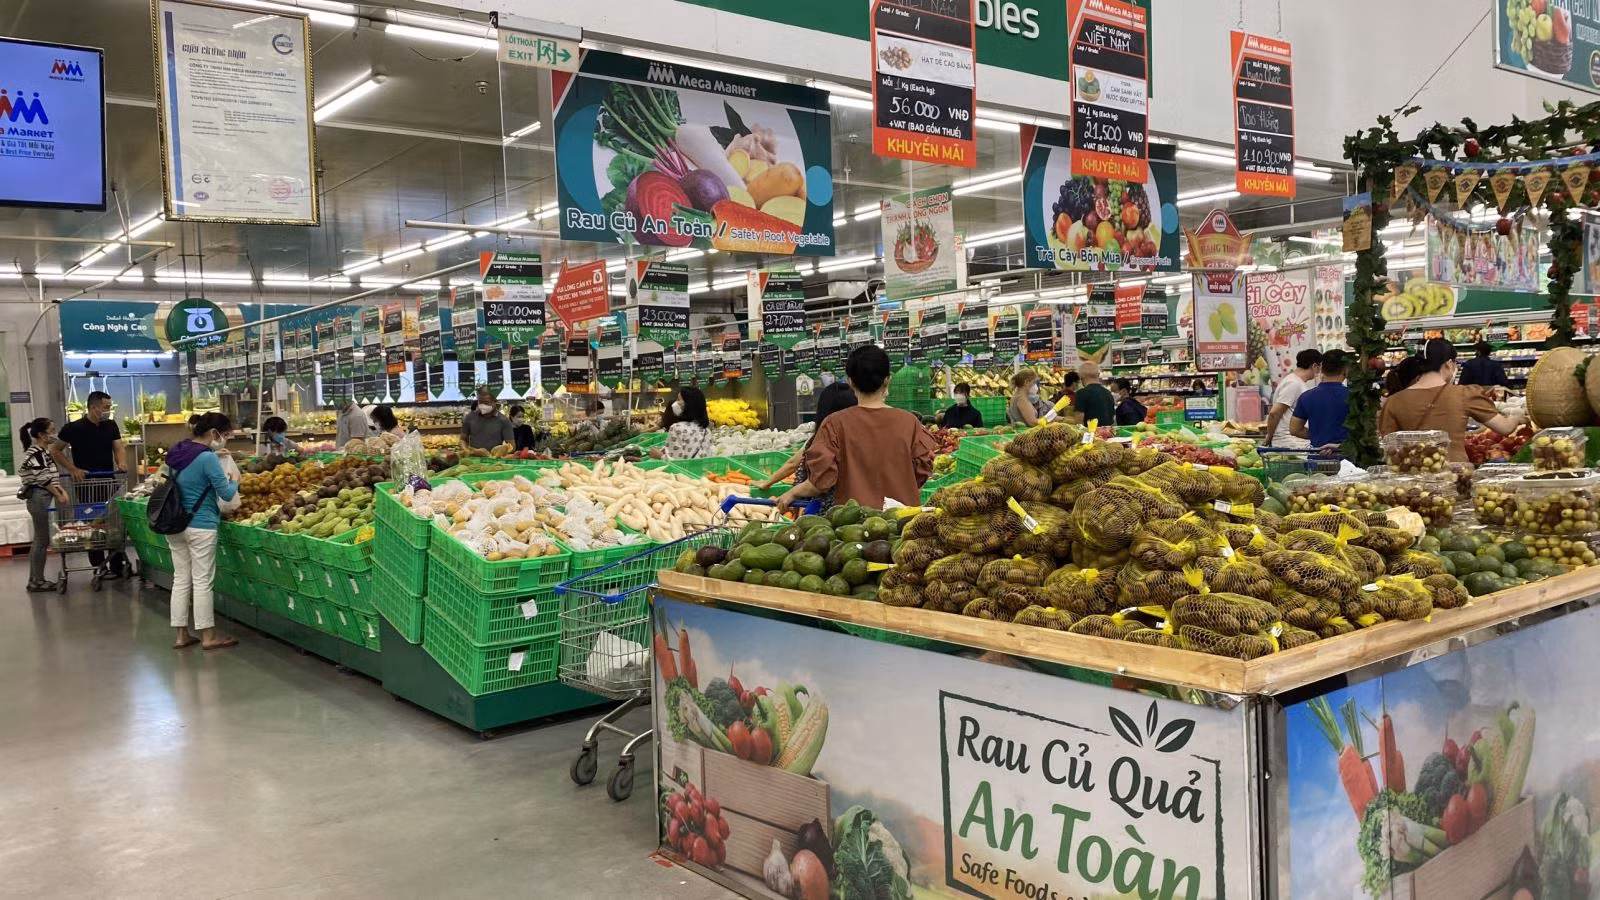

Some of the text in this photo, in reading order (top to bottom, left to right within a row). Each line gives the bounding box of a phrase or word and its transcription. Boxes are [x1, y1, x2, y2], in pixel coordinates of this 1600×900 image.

[508, 49, 533, 61] EXIT
[679, 75, 757, 99] Mega Market
[890, 97, 970, 122] 56.000 VNĐ
[889, 120, 907, 129] +VAT
[908, 121, 924, 132] (BAO
[1084, 120, 1144, 143] 21.500 VNĐ
[888, 137, 964, 161] KHUYẾN MÃI
[1082, 157, 1140, 178] KHUYẾN MÃI
[1244, 176, 1275, 191] KHUYẾN
[567, 207, 605, 231] Rau
[609, 211, 637, 233] Củ
[643, 215, 668, 237] An
[671, 217, 714, 238] Toàn
[731, 227, 761, 242] Safety
[764, 229, 785, 243] Root
[788, 232, 831, 248] Vegetable
[1264, 281, 1306, 305] Cây
[131, 323, 148, 331] Cao
[956, 715, 1205, 824] Rau Củ Quả
[957, 780, 1201, 900] An Toàn
[958, 853, 1058, 900] Safe Foods
